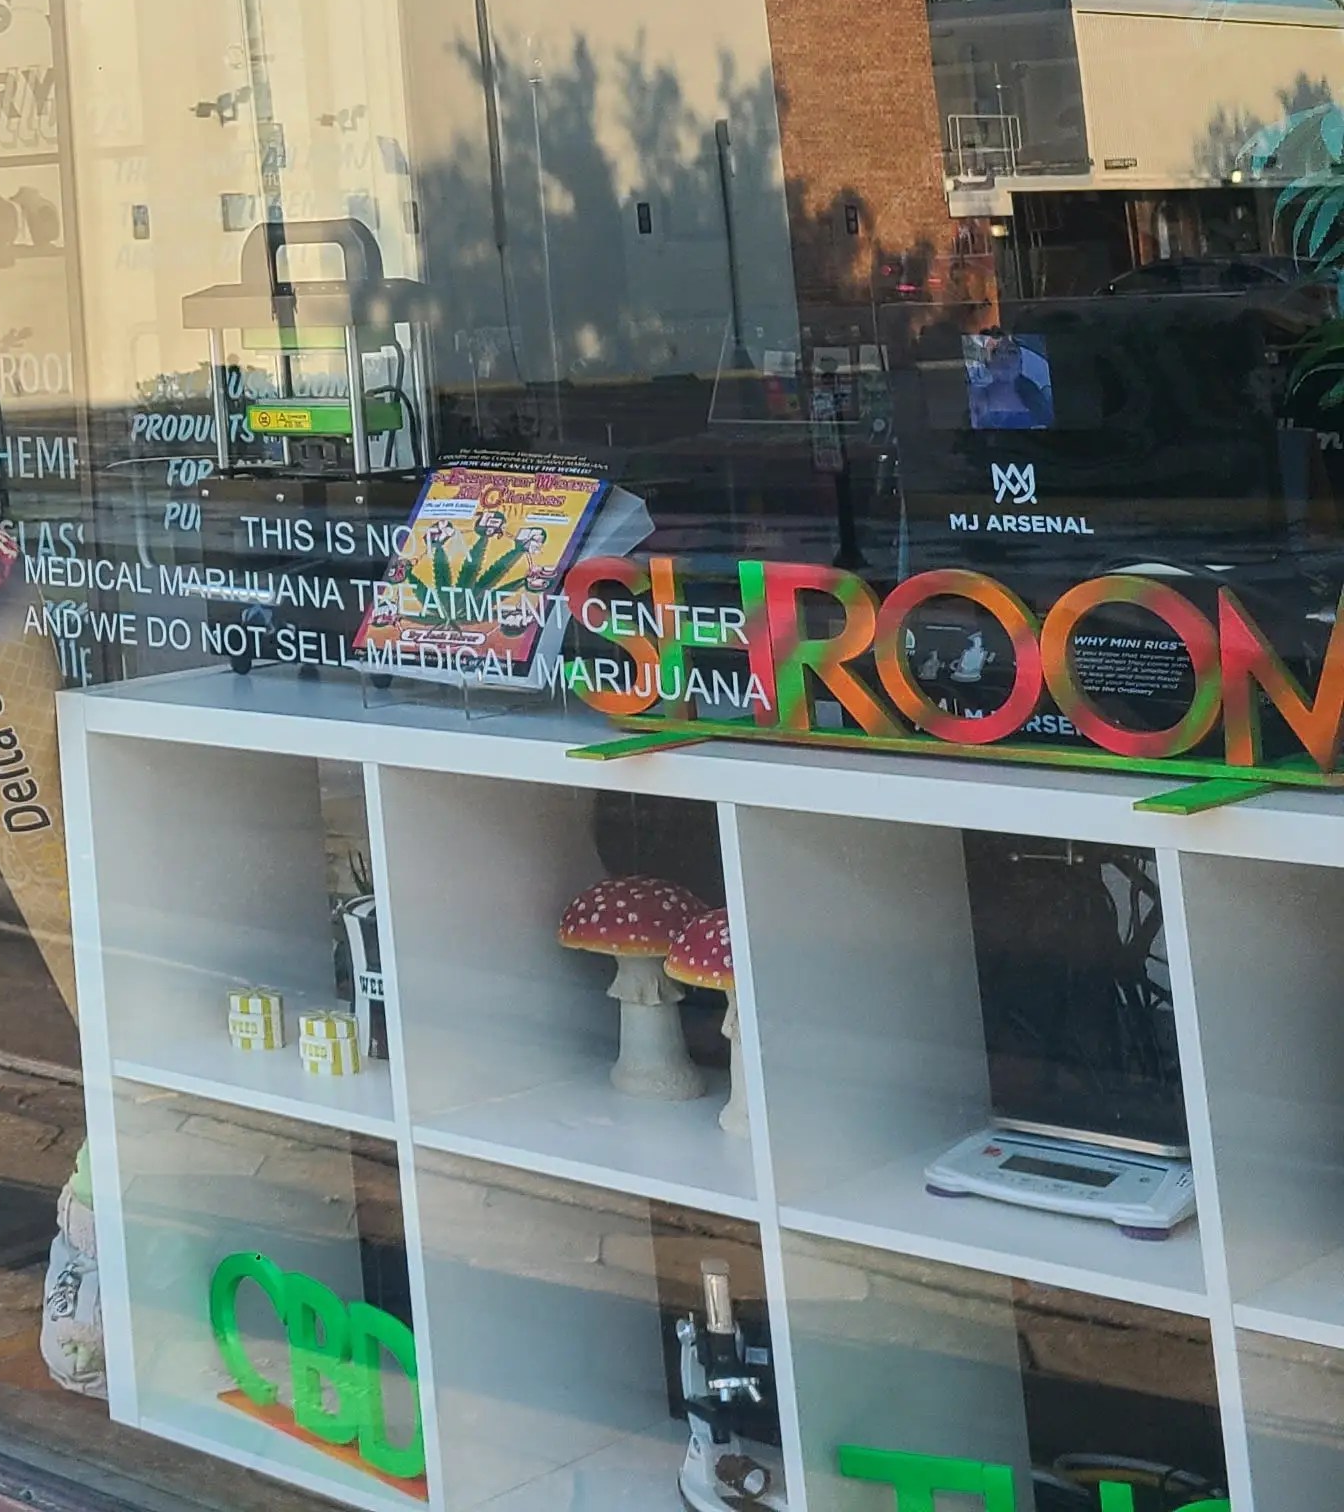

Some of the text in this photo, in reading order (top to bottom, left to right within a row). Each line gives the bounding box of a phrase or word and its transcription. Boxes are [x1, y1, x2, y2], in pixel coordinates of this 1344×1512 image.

[240, 516, 313, 553] THIS
[326, 520, 355, 554] IS
[950, 514, 1094, 535] MJ ARSENAL
[24, 555, 749, 645] MEDICAL MARIJUANA TREATMENT CENTER
[23, 605, 82, 639] AND
[90, 610, 138, 646] WE
[146, 620, 192, 652] DO
[201, 624, 266, 660] NOT
[277, 628, 351, 668] SELL
[367, 638, 515, 683] MEDICAL
[536, 654, 772, 711] MARIJUANA
[1074, 635, 1108, 647] WHY
[1110, 638, 1142, 649] MINI
[359, 975, 385, 996] WEE
[210, 1251, 427, 1478] CBD
